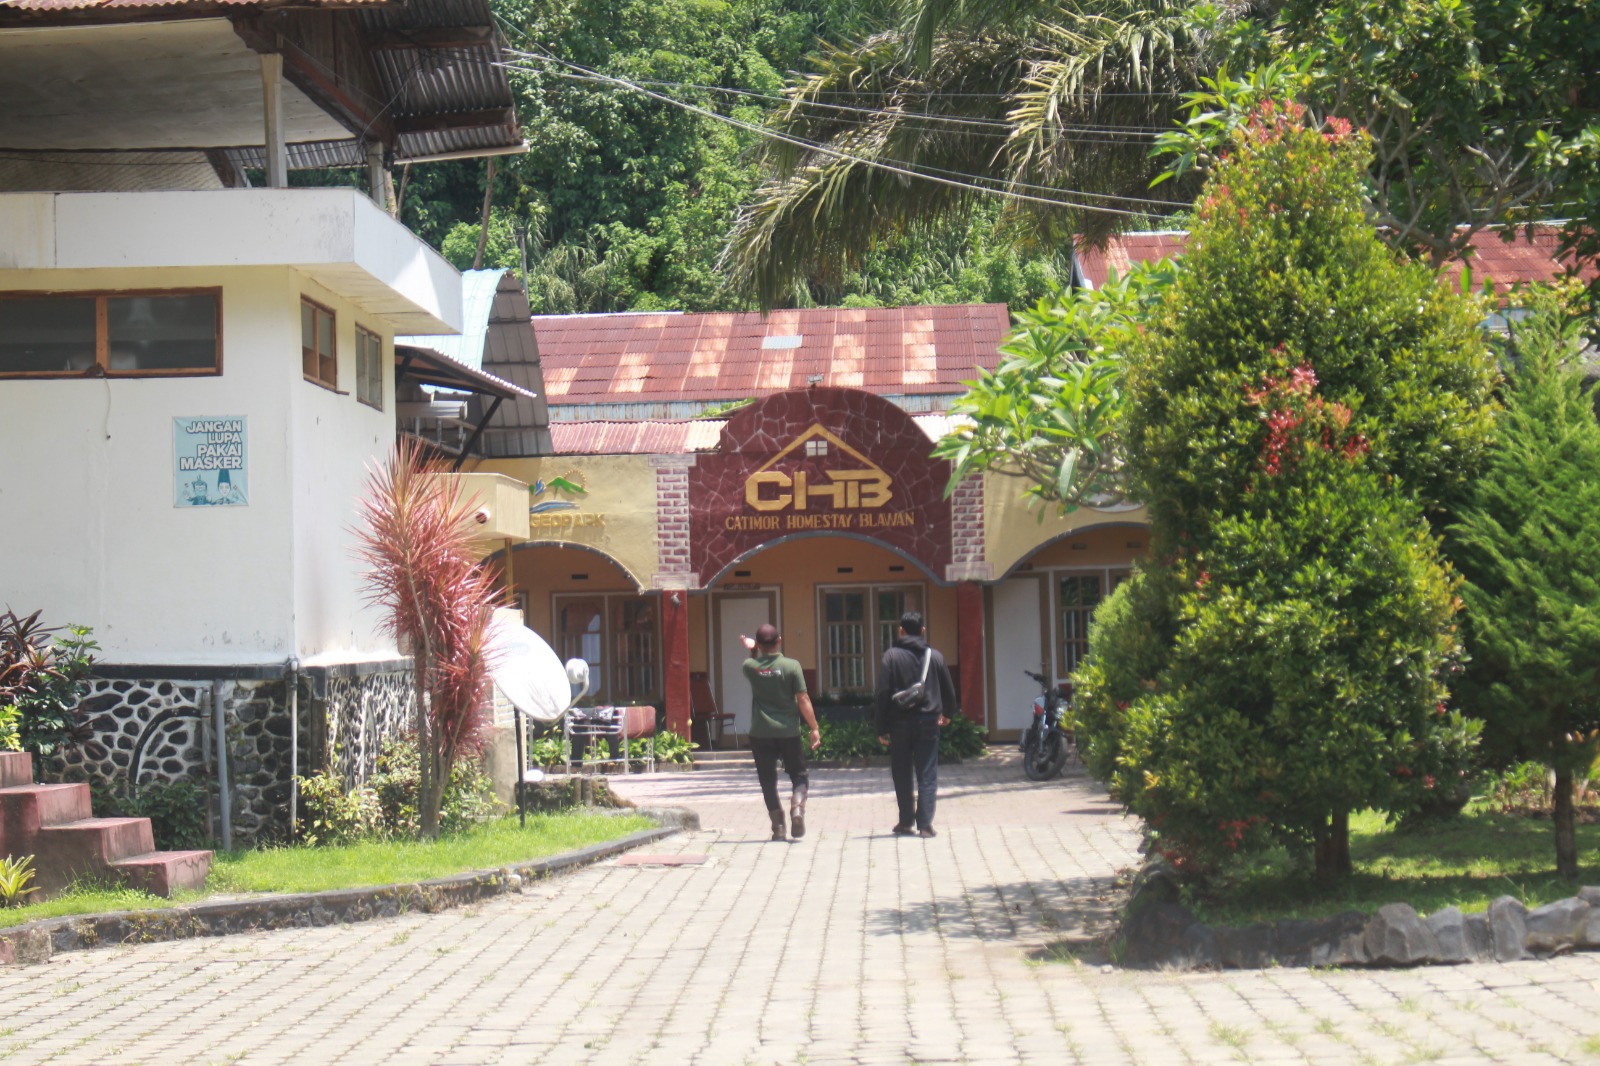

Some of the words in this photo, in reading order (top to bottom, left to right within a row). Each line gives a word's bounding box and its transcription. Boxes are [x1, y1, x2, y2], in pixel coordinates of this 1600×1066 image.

[186, 420, 242, 433] JANGAN
[207, 432, 241, 444] LUPA
[197, 444, 242, 457] PAKAI
[180, 457, 242, 470] MASKER
[745, 470, 892, 511] CHB
[530, 513, 605, 527] GEOPARK
[725, 516, 780, 530] CATIMOR
[787, 514, 852, 529] HOMESTAY
[860, 512, 914, 527] BLAWAN
